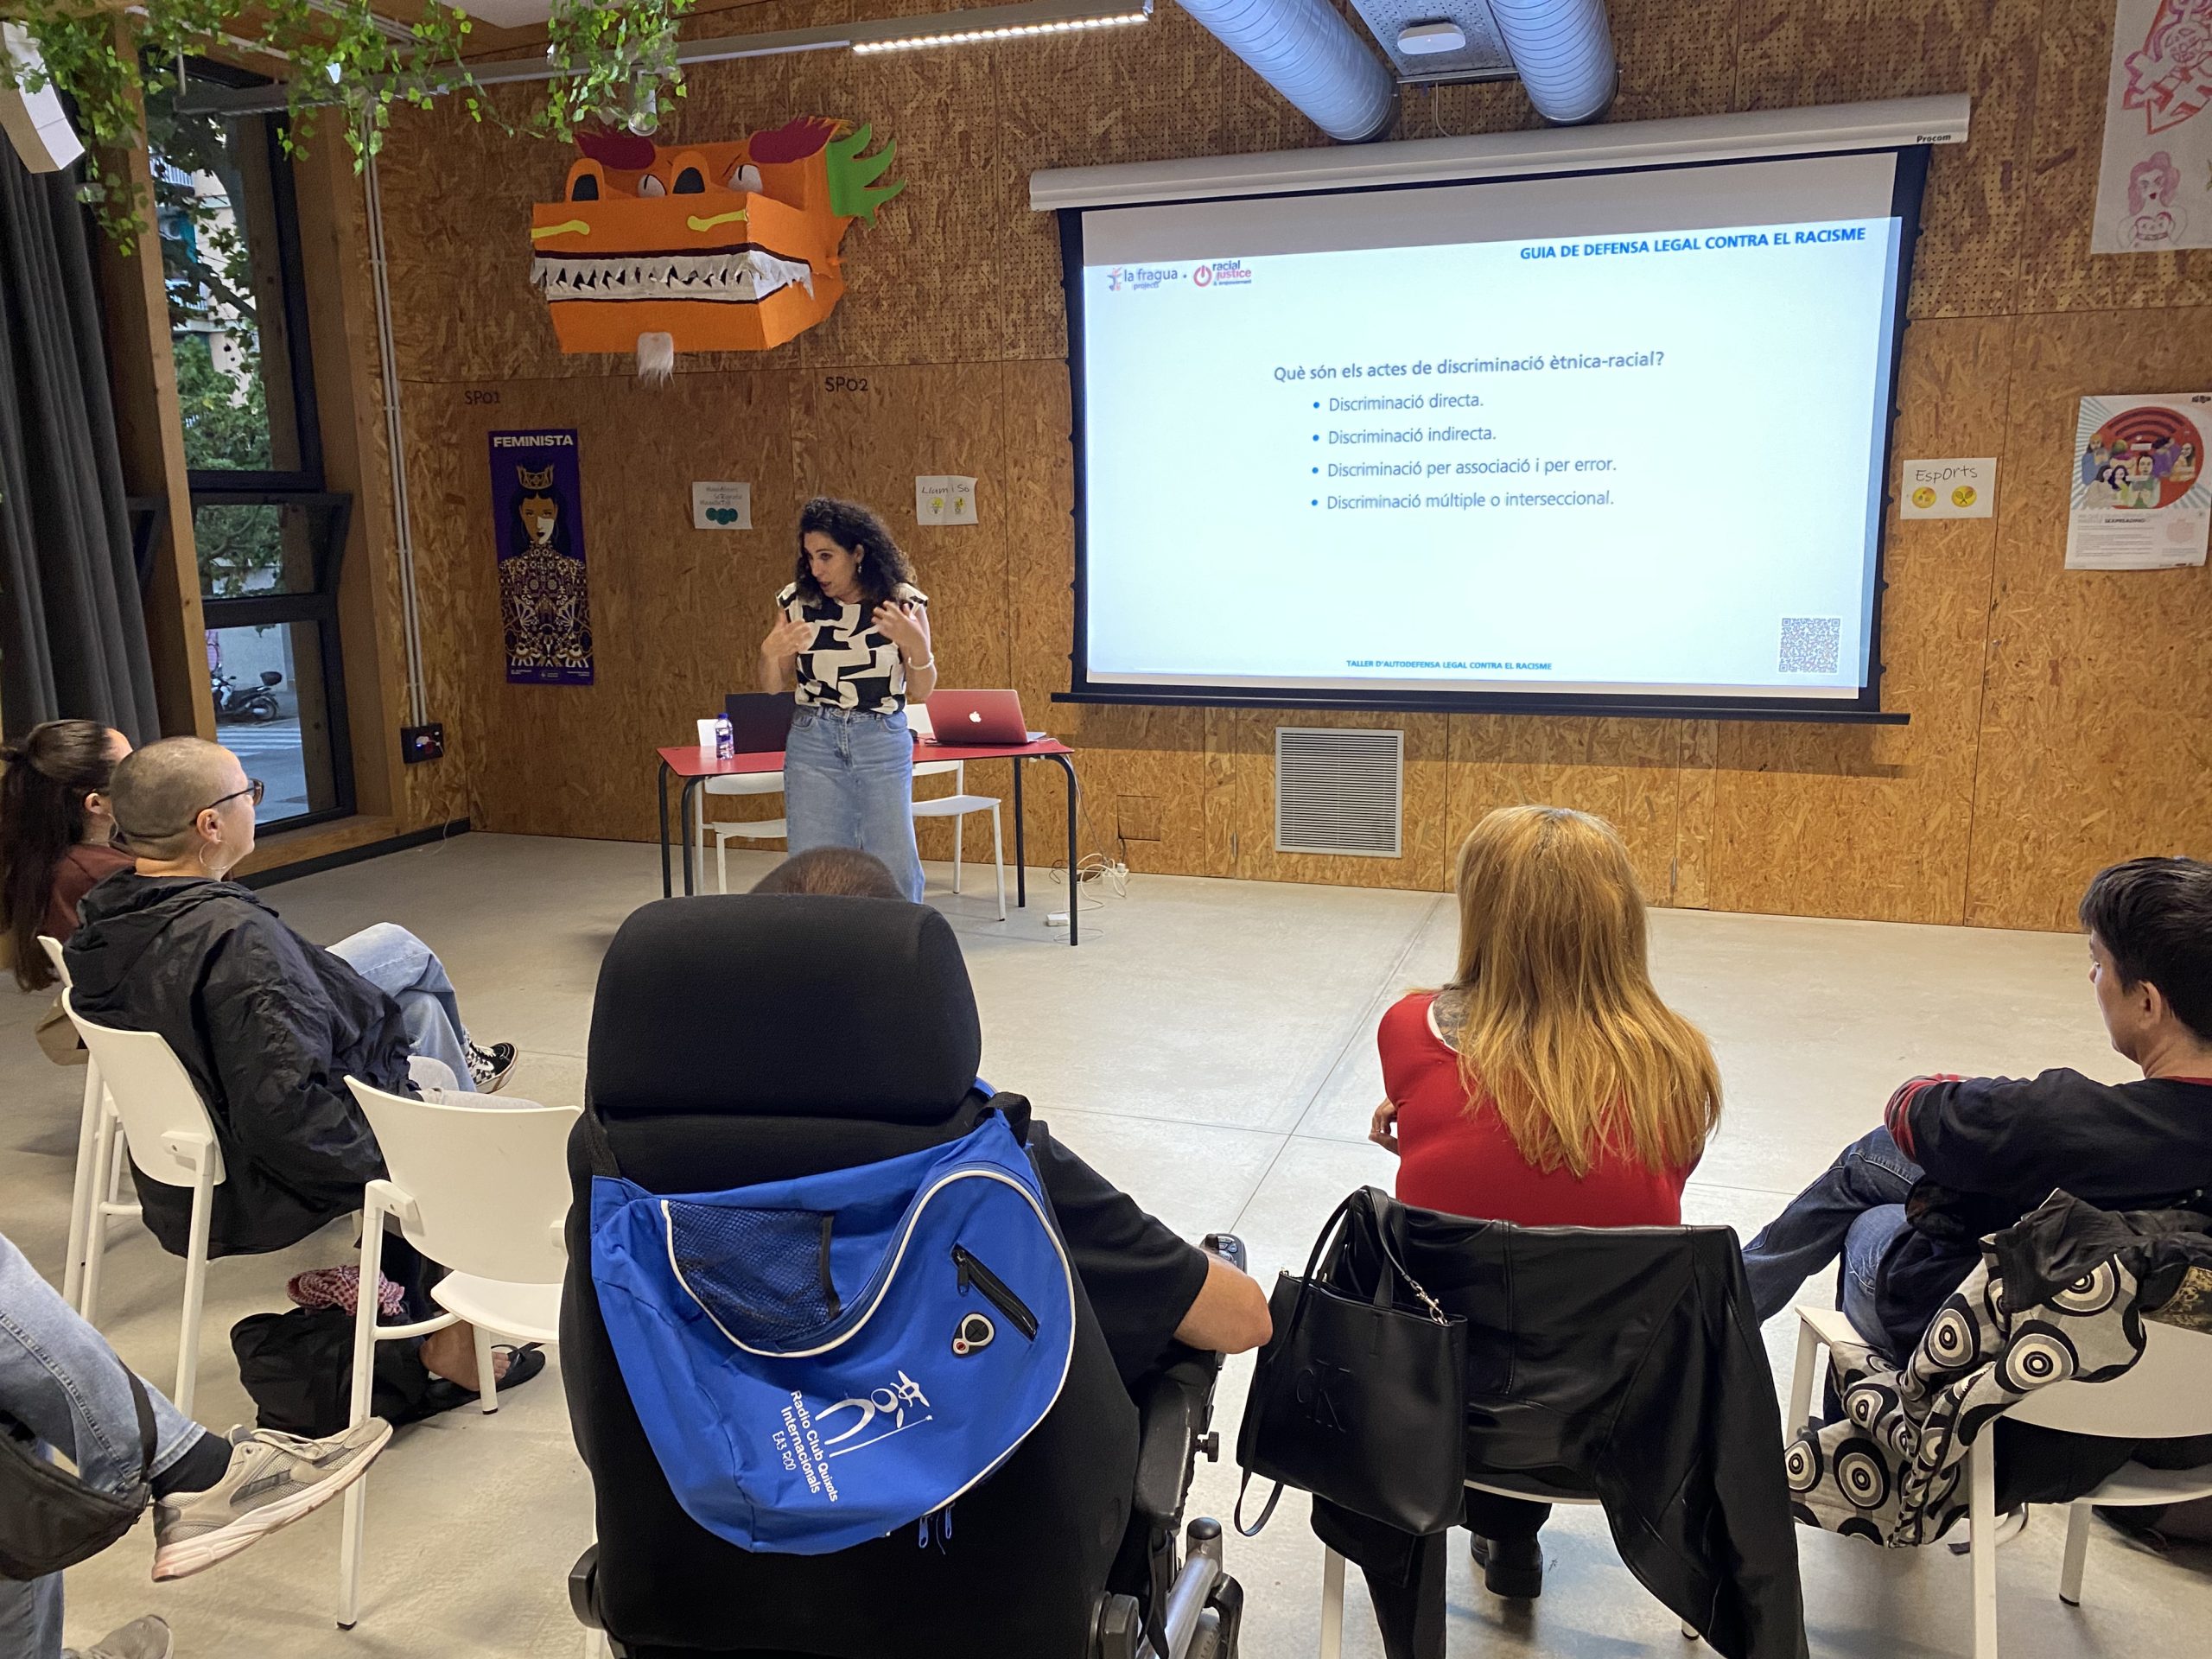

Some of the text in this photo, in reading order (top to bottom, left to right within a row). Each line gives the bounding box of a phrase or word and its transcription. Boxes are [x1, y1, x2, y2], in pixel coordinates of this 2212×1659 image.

[1520, 227, 1866, 260] GUIA DE DEFENSA LEGAL CONTRA EL RACISME
[1212, 260, 1241, 271] racial
[1216, 269, 1252, 281] justice
[1124, 268, 1178, 283] la fragua
[1274, 351, 1664, 383] Què són els actes de discriminació ètnica-racial?
[1329, 393, 1484, 411] Discriminació directa.
[493, 435, 574, 448] FEMINISTA
[1328, 426, 1497, 444] Discriminació indirecta.
[1328, 457, 1617, 479] Discriminació per associació i per error.
[1327, 490, 1614, 511] Discriminació múltiple o interseccional.
[1376, 660, 1440, 669] D'AUTODEFENSA
[1516, 662, 1553, 671] RACISME
[772, 1430, 787, 1451] EA3
[780, 1406, 820, 1494] Internacionals
[790, 1389, 838, 1502] Radio Club Quixots
